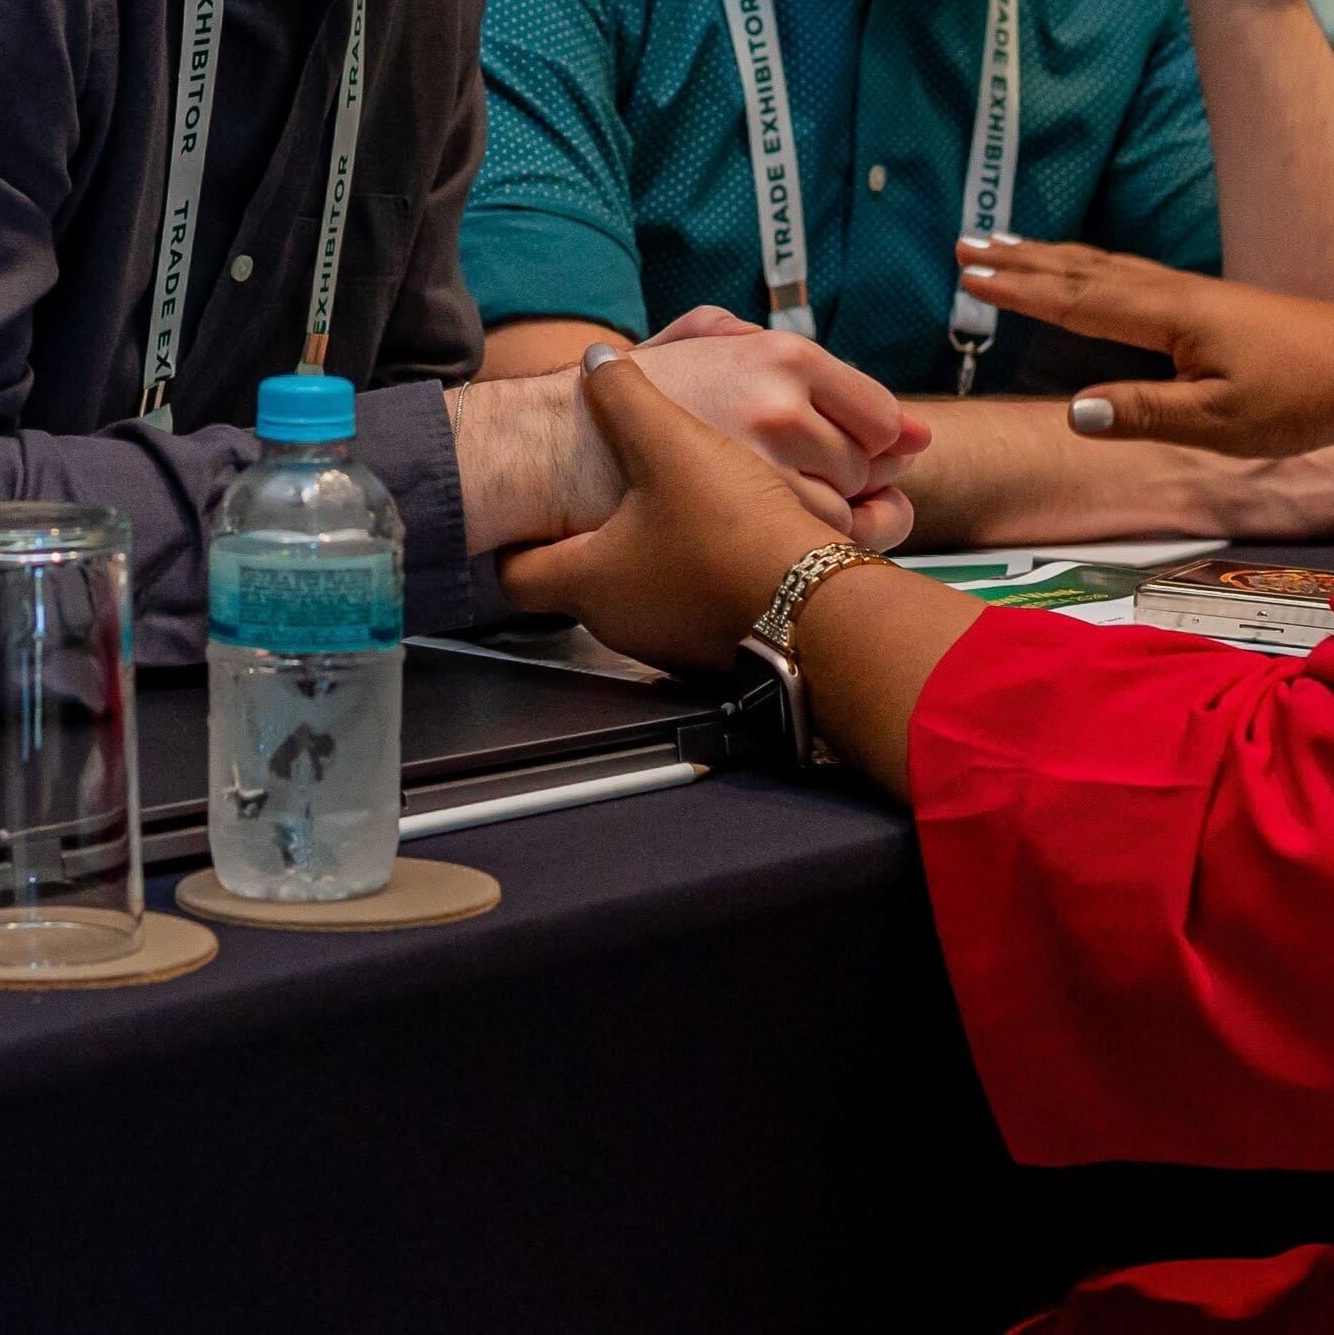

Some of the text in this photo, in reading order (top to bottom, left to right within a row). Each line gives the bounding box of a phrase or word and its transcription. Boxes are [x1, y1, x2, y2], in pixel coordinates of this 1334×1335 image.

[766, 162, 794, 266] TRADE
[975, 74, 1008, 234] EXHIBITOR
[161, 199, 190, 320] TRADE
[312, 154, 349, 335] EXHIBITOR
